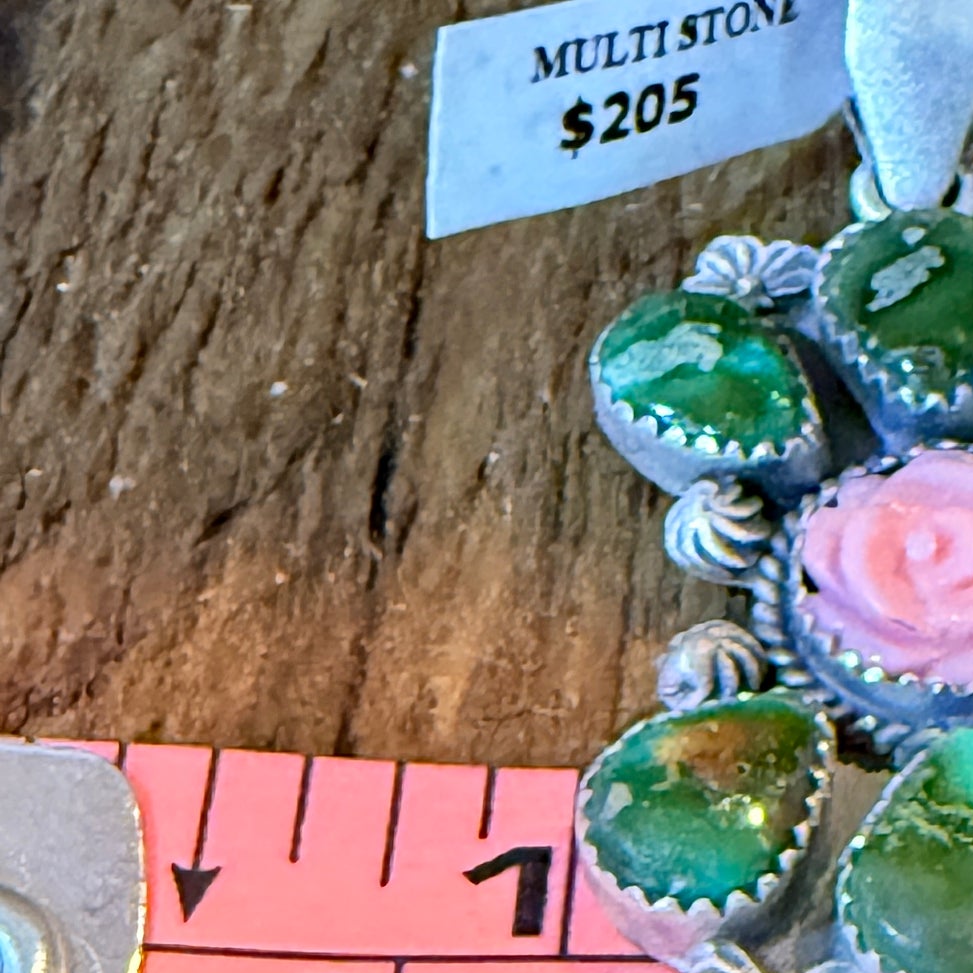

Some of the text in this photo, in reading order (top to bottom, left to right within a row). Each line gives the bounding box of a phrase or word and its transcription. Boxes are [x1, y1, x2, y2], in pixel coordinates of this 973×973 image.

[531, 20, 669, 83] MULTI
[560, 72, 700, 159] $205
[462, 845, 552, 938] 1
